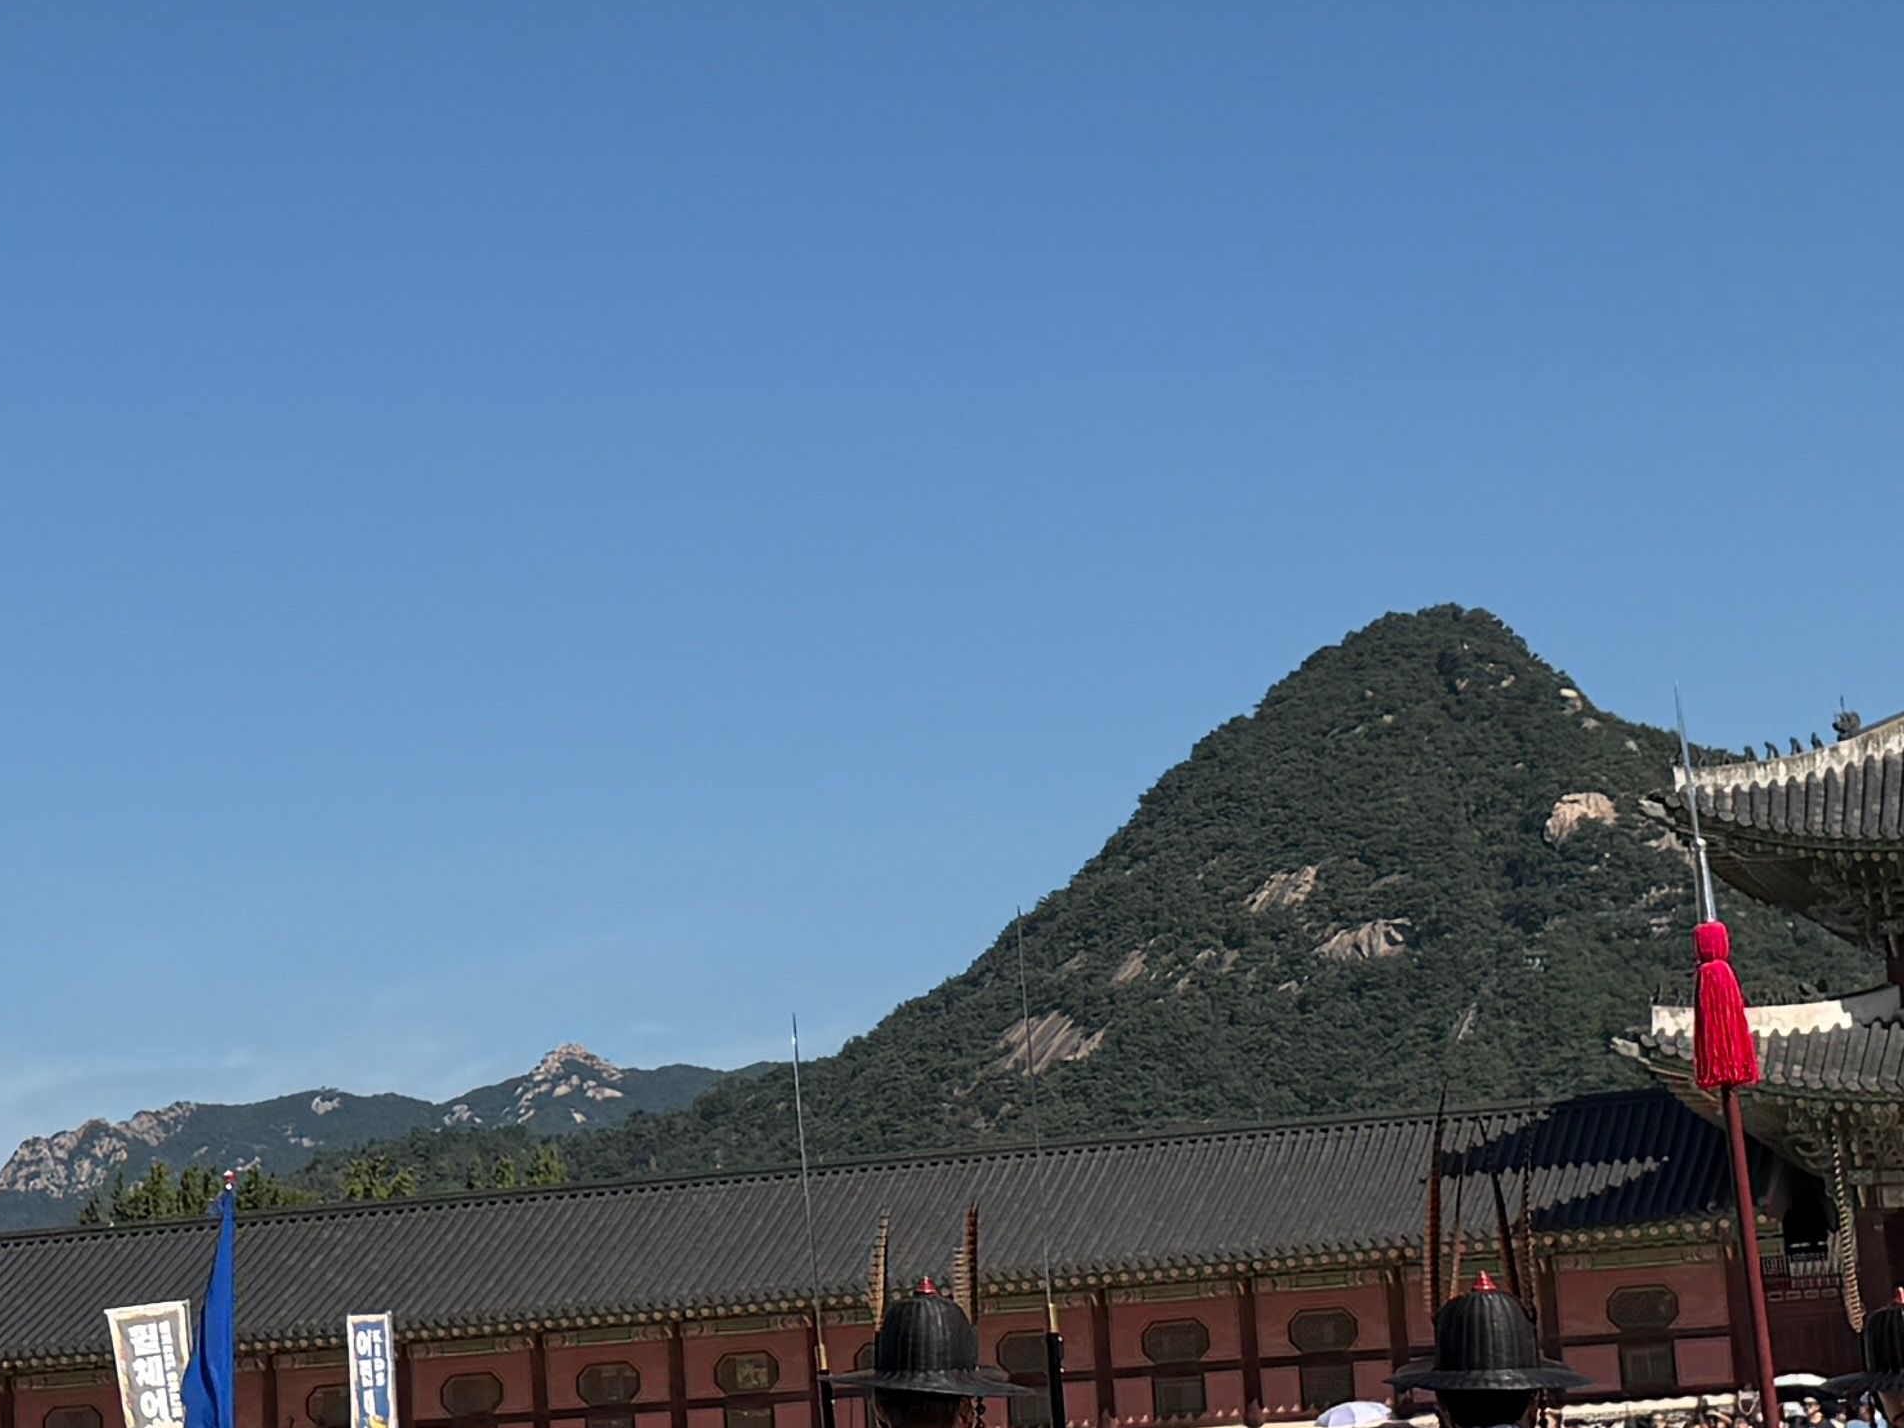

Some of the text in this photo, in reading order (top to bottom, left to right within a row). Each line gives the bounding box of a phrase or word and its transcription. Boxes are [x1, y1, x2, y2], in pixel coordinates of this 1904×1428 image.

[127, 1322, 170, 1421] 휠체어
[356, 1329, 376, 1415] 어린이
[372, 1329, 386, 1387] KIDS
